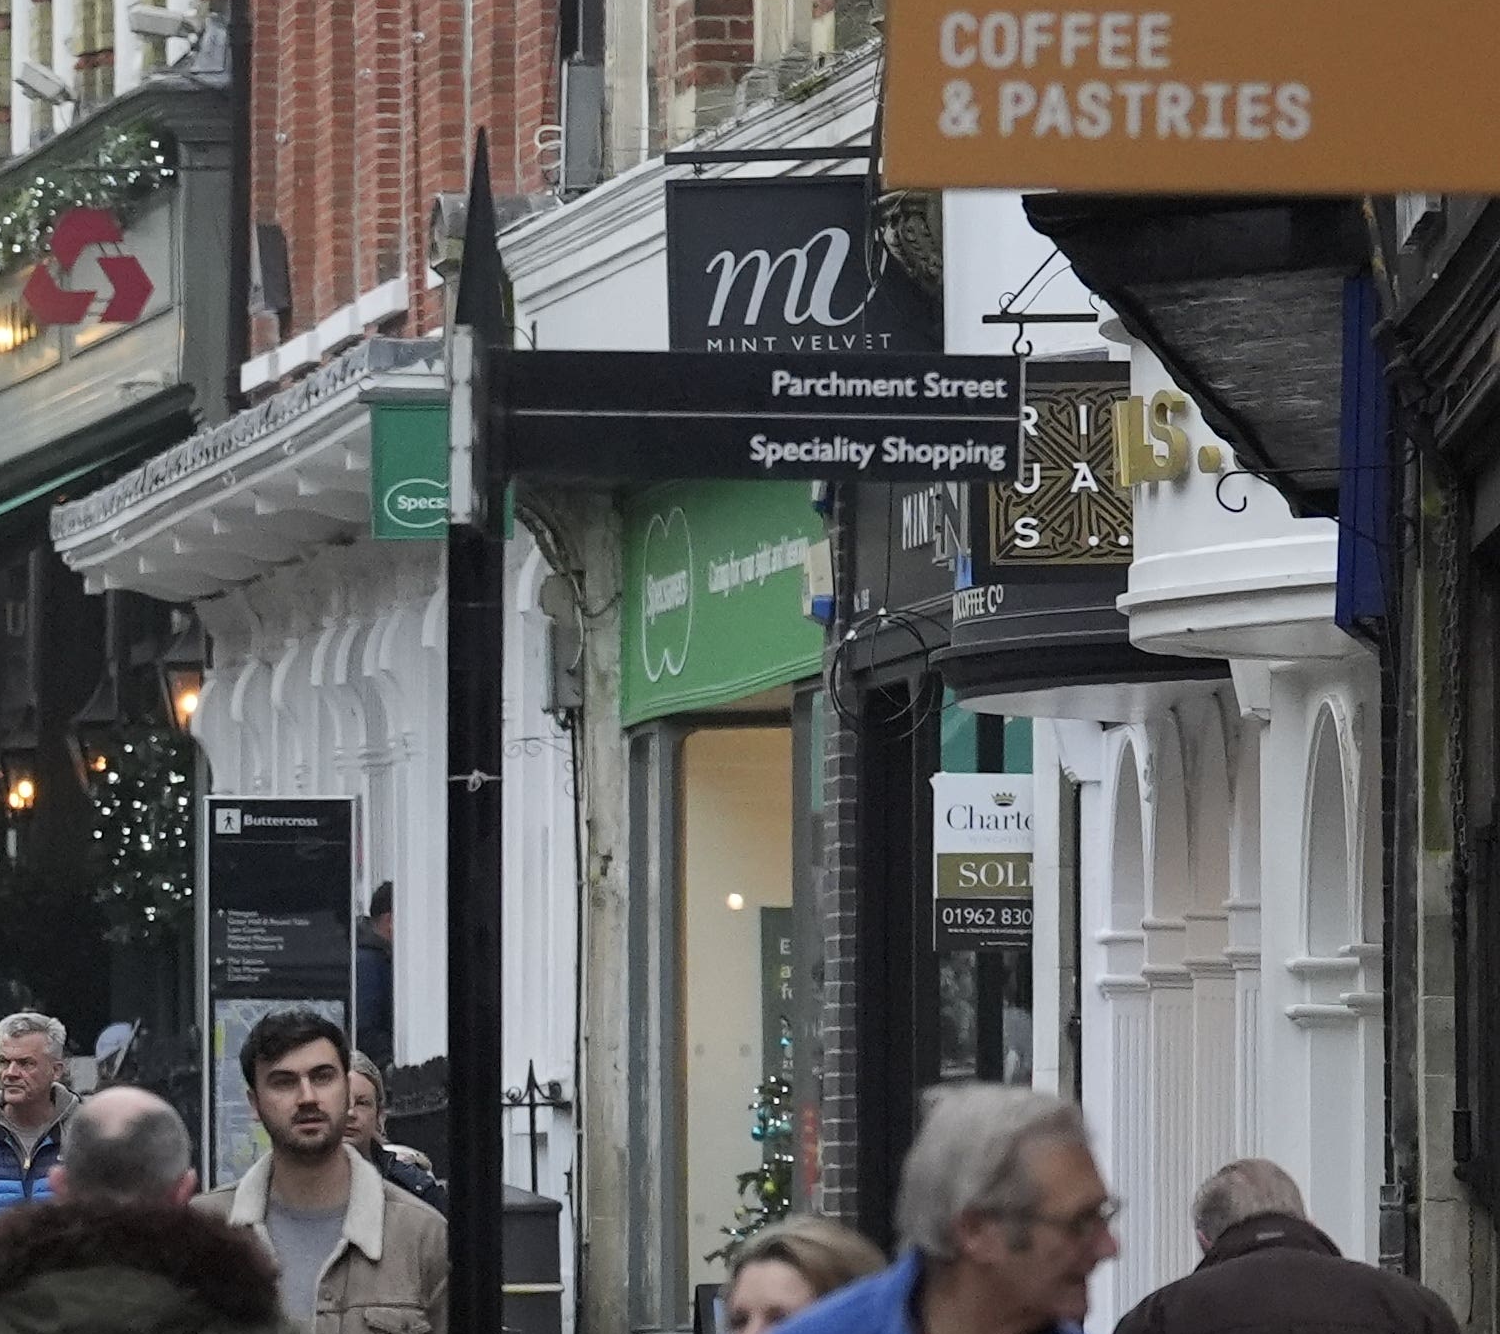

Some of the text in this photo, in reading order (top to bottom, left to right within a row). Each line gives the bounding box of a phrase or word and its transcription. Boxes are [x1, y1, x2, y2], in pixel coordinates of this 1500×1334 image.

[939, 10, 1172, 69] COFFEE
[938, 79, 1312, 140] & PASTRIES
[707, 333, 892, 353] MINT VELVET
[771, 369, 1008, 399] Parchment Street
[749, 434, 1007, 471] Speciality Shopping
[243, 814, 319, 827] Buttercross
[942, 907, 1034, 926] 01962 830
